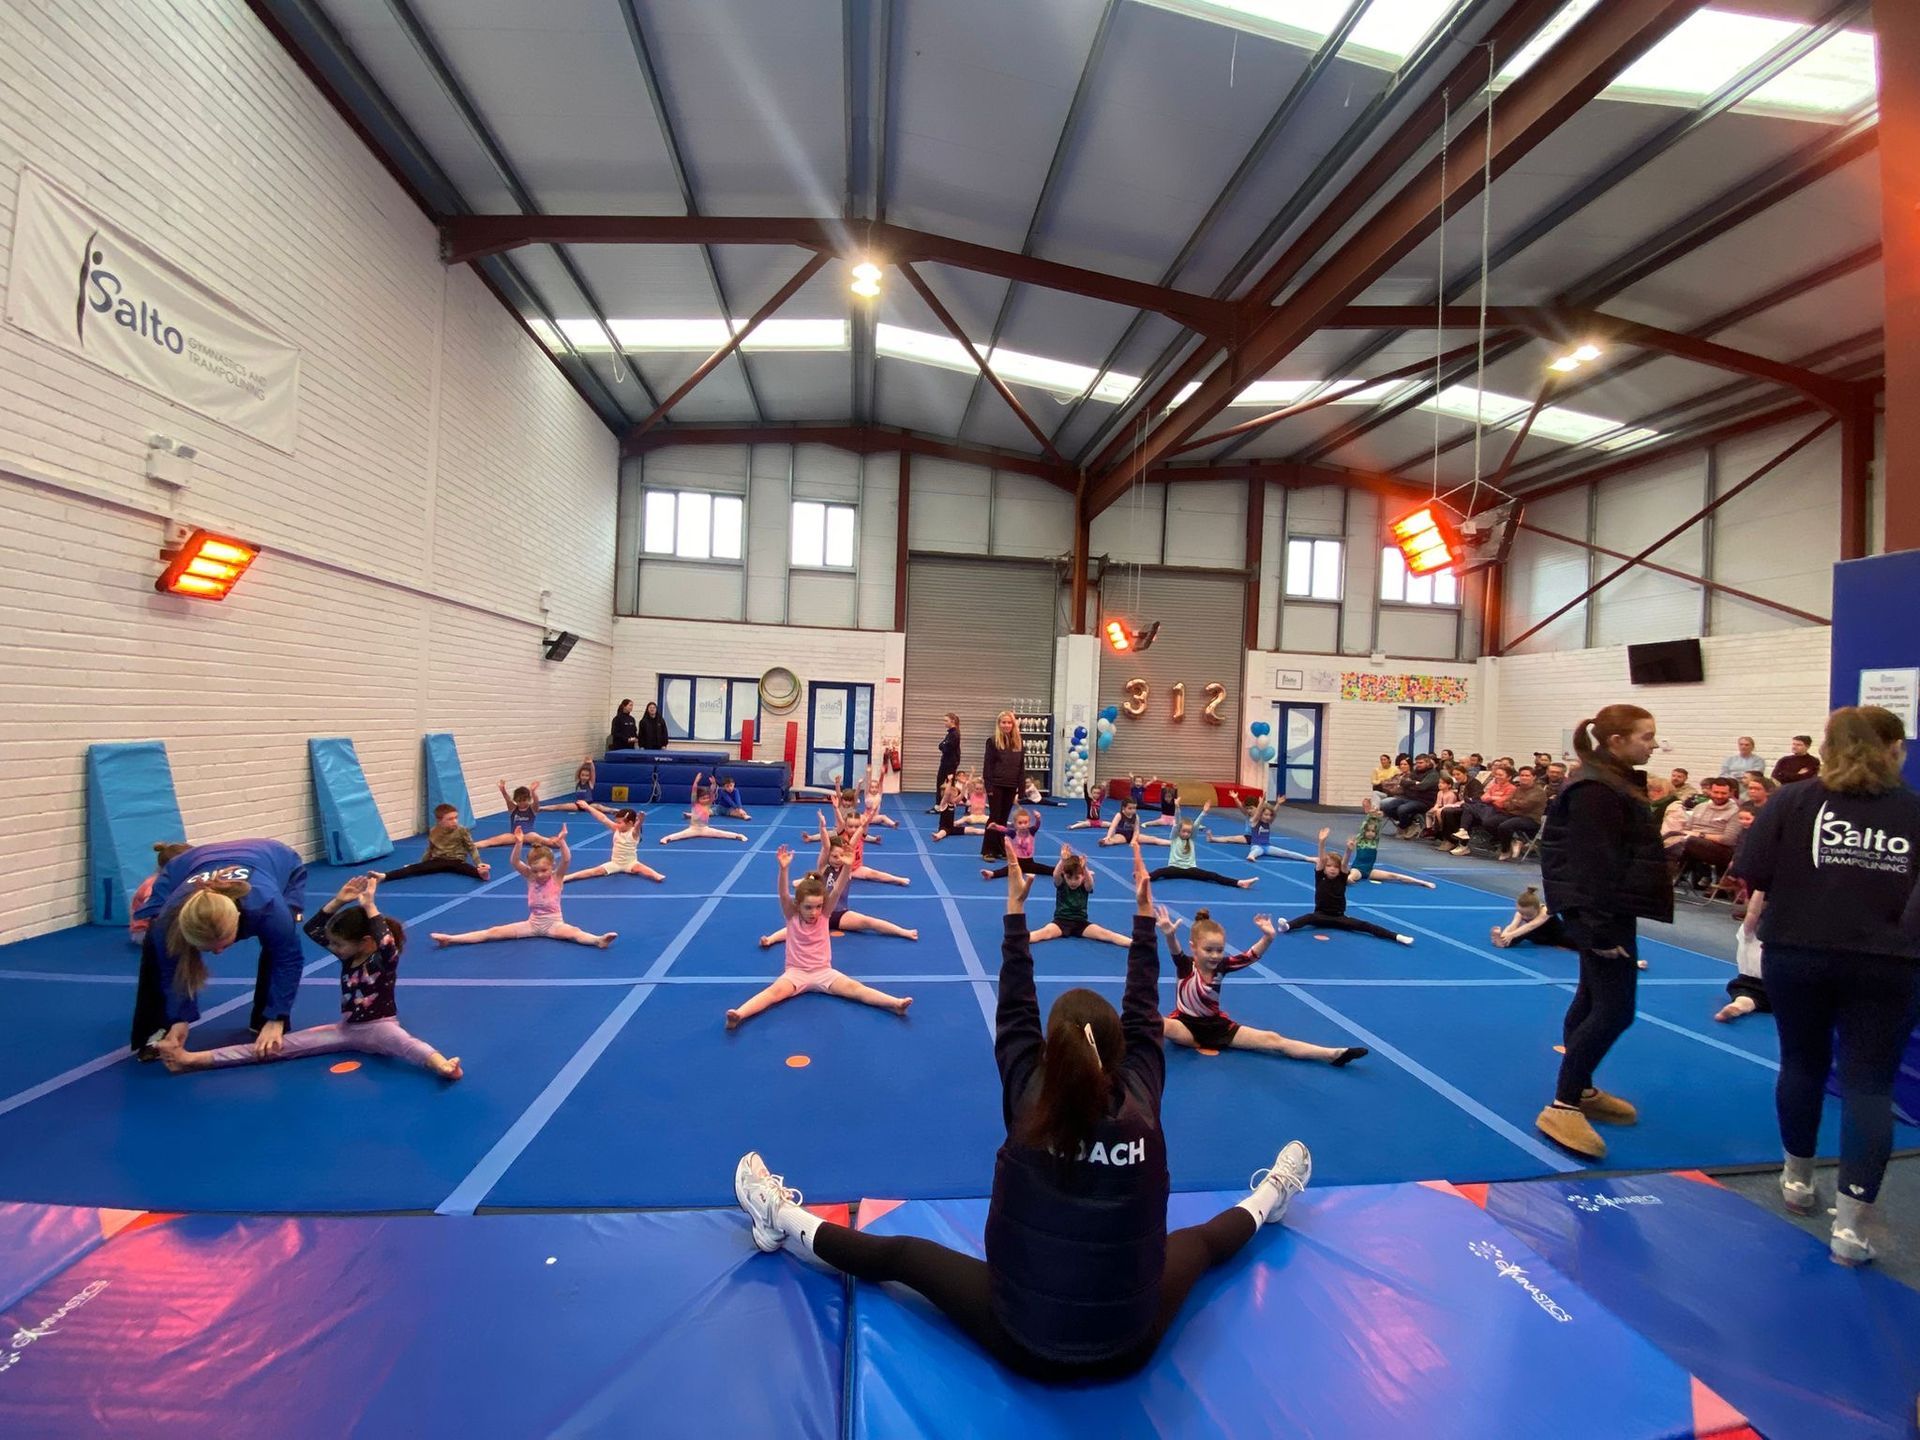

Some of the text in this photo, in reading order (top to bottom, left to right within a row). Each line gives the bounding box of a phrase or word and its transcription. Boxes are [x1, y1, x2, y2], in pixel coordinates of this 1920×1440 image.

[89, 268, 185, 355] Salto
[187, 337, 268, 387] GYMNASTICS AND
[187, 349, 266, 401] TRAMPOLINING
[1122, 677, 1150, 718] 3
[1171, 681, 1186, 724] 1
[1203, 681, 1228, 727] 2
[1820, 847, 1909, 864] GYMNASTICS AND
[1821, 819, 1910, 854] Salto
[1819, 855, 1908, 874] TRAMPOLINING
[1048, 1137, 1146, 1167] ACH
[1494, 1259, 1574, 1323] GYMNASTICS
